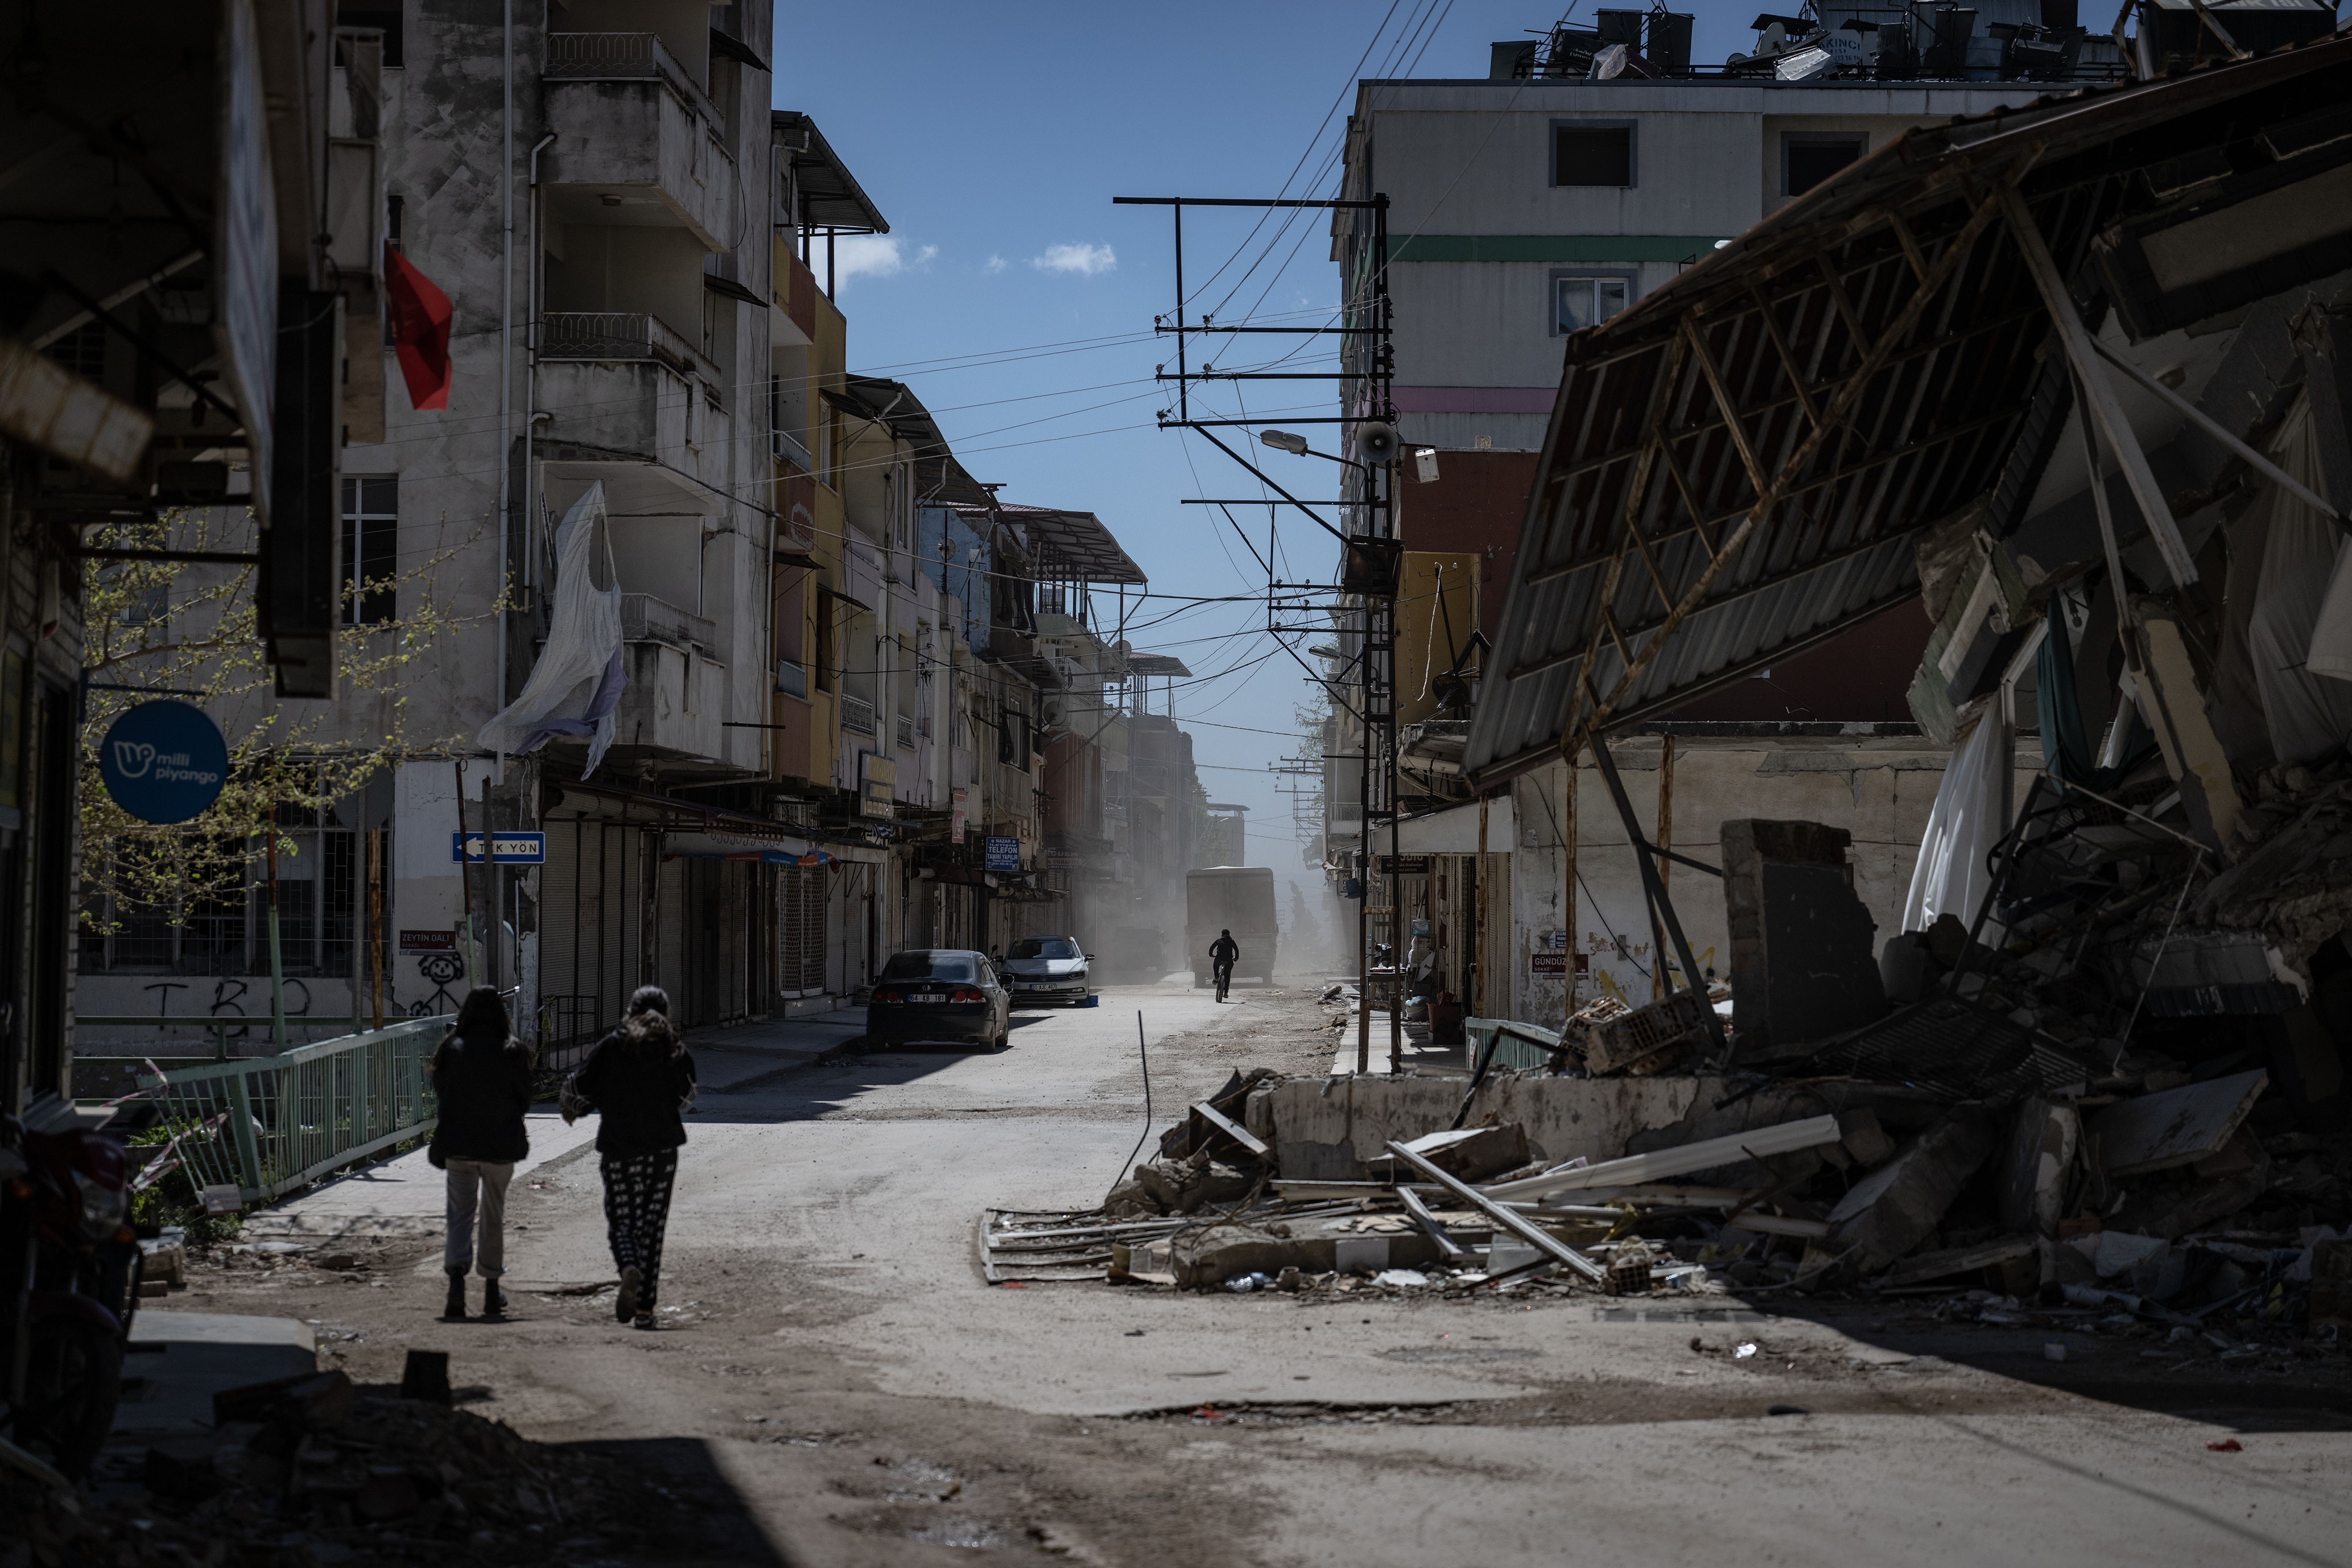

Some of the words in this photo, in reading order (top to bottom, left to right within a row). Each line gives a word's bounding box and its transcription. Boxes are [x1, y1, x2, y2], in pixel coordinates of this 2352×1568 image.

[1820, 38, 1860, 51] AKINCI
[156, 753, 190, 767] milli
[155, 766, 218, 785] piyango
[479, 844, 503, 852] TK
[510, 841, 537, 852] YÖN
[402, 933, 430, 942] ZEYTİN
[1534, 956, 1566, 965] GÜNDÜZ
